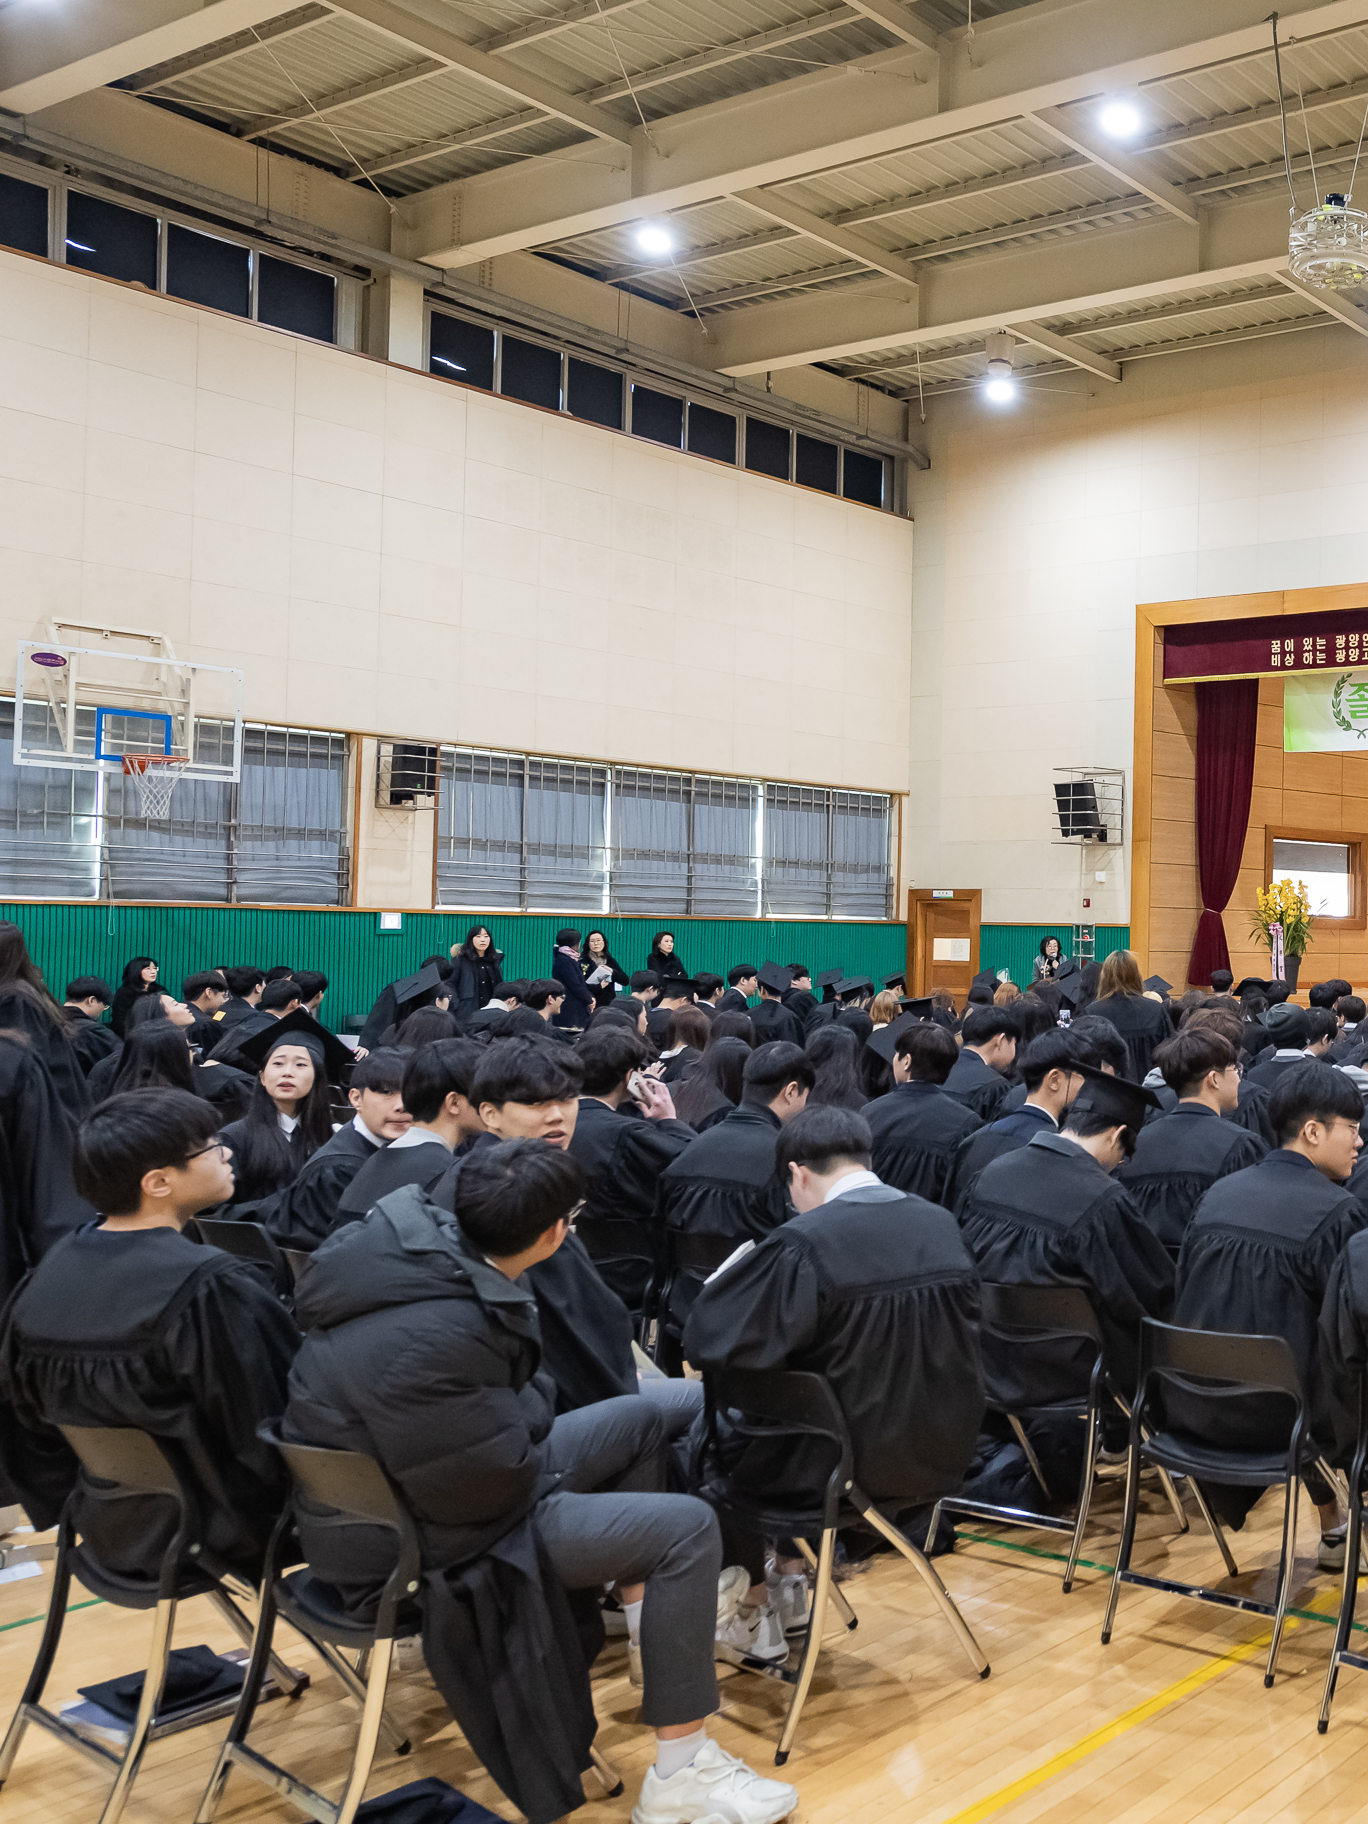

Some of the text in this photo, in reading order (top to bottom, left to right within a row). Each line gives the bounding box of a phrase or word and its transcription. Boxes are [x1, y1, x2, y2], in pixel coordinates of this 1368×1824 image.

[1271, 639, 1294, 653] 꿈이
[1303, 637, 1326, 651] 있는
[1271, 654, 1295, 667] 비상
[1303, 652, 1326, 665] 하는
